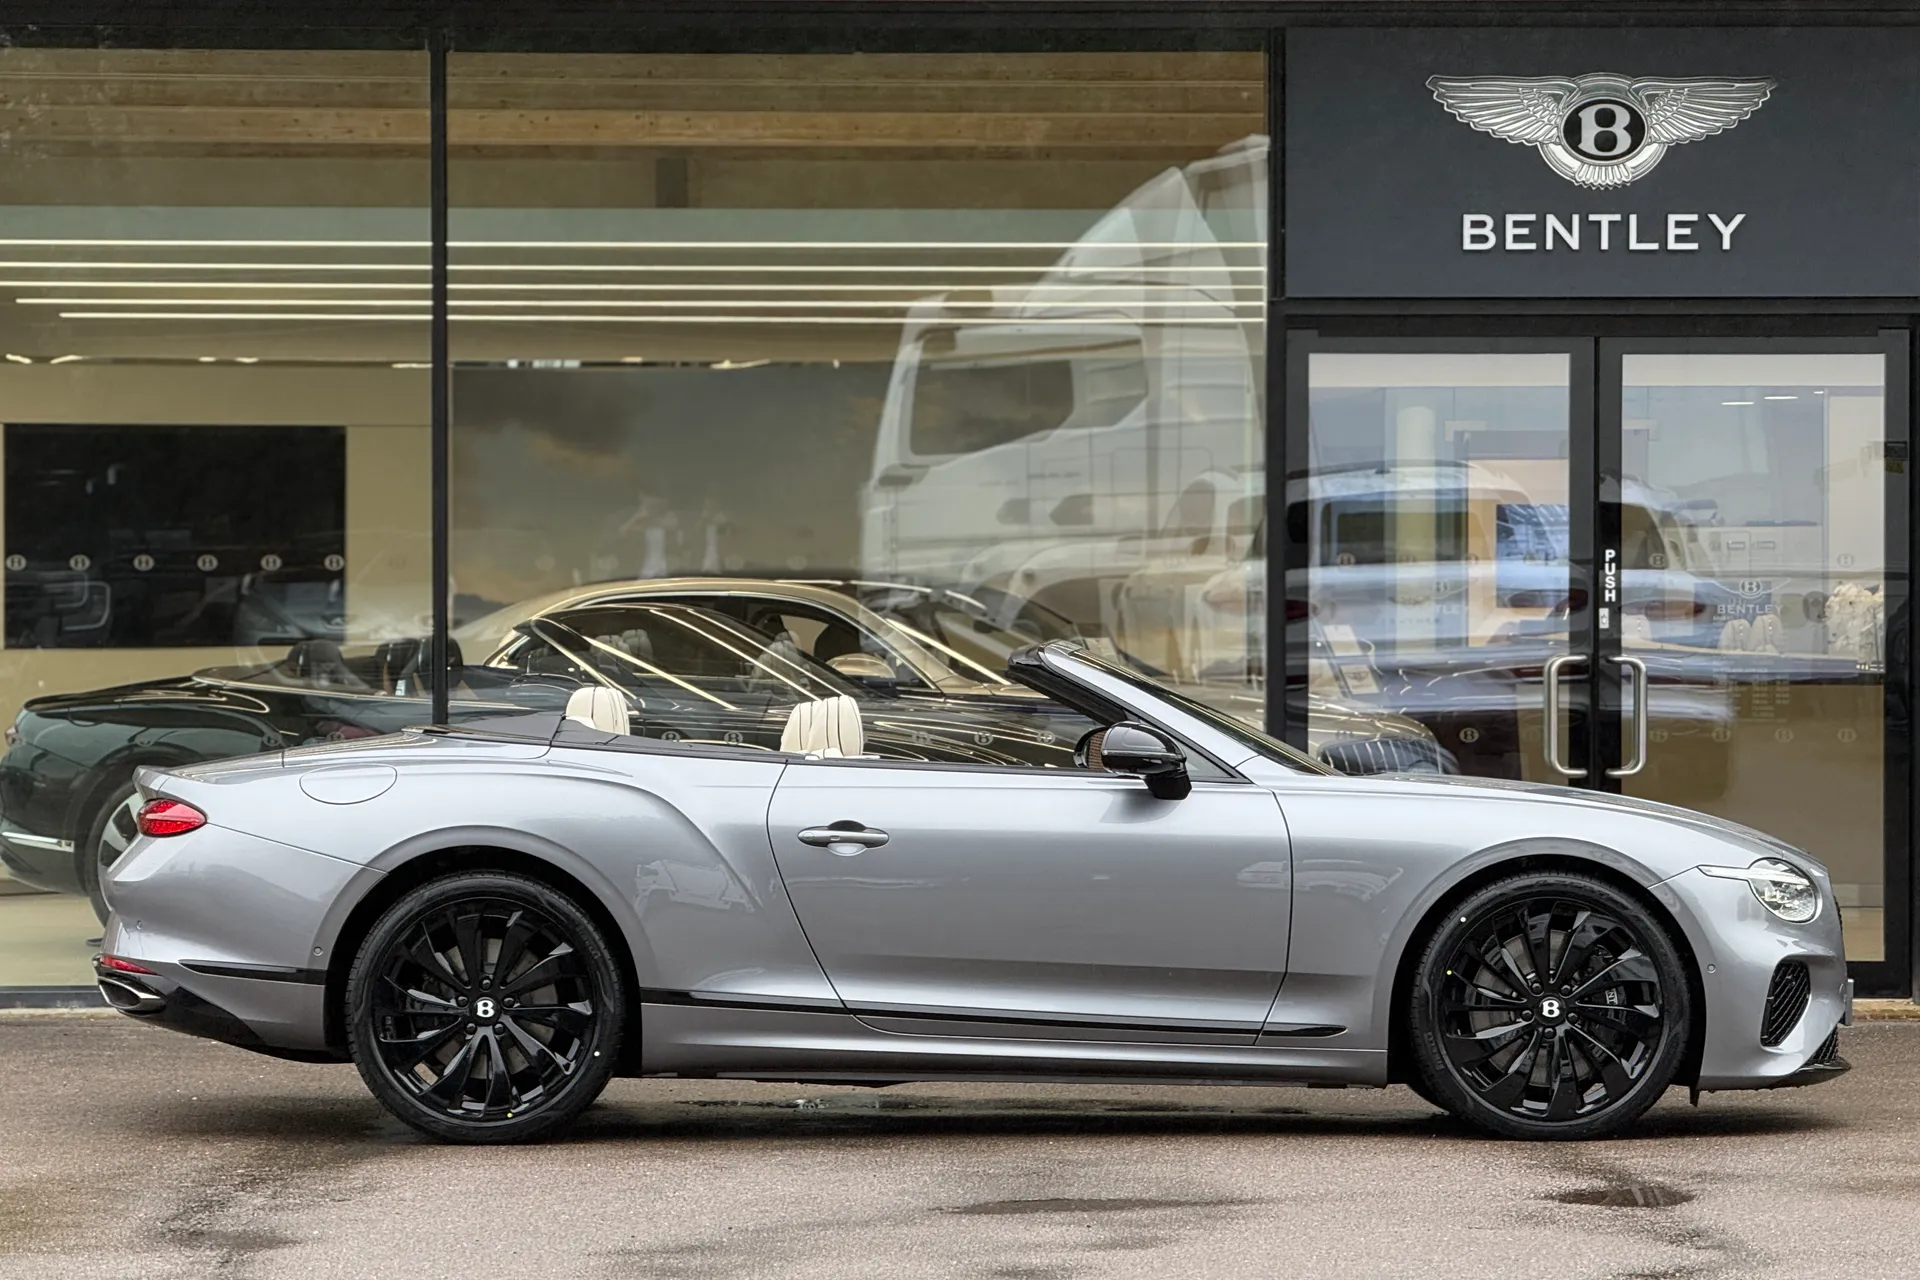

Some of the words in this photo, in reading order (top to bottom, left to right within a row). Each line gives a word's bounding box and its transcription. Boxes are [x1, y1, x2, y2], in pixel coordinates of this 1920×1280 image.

[1577, 103, 1632, 156] B
[1462, 213, 1747, 251] BENTLEY
[1604, 548, 1616, 602] PUSH
[1717, 604, 1784, 614] BENTLEY
[477, 1000, 495, 1018] B
[1542, 1000, 1560, 1018] B
